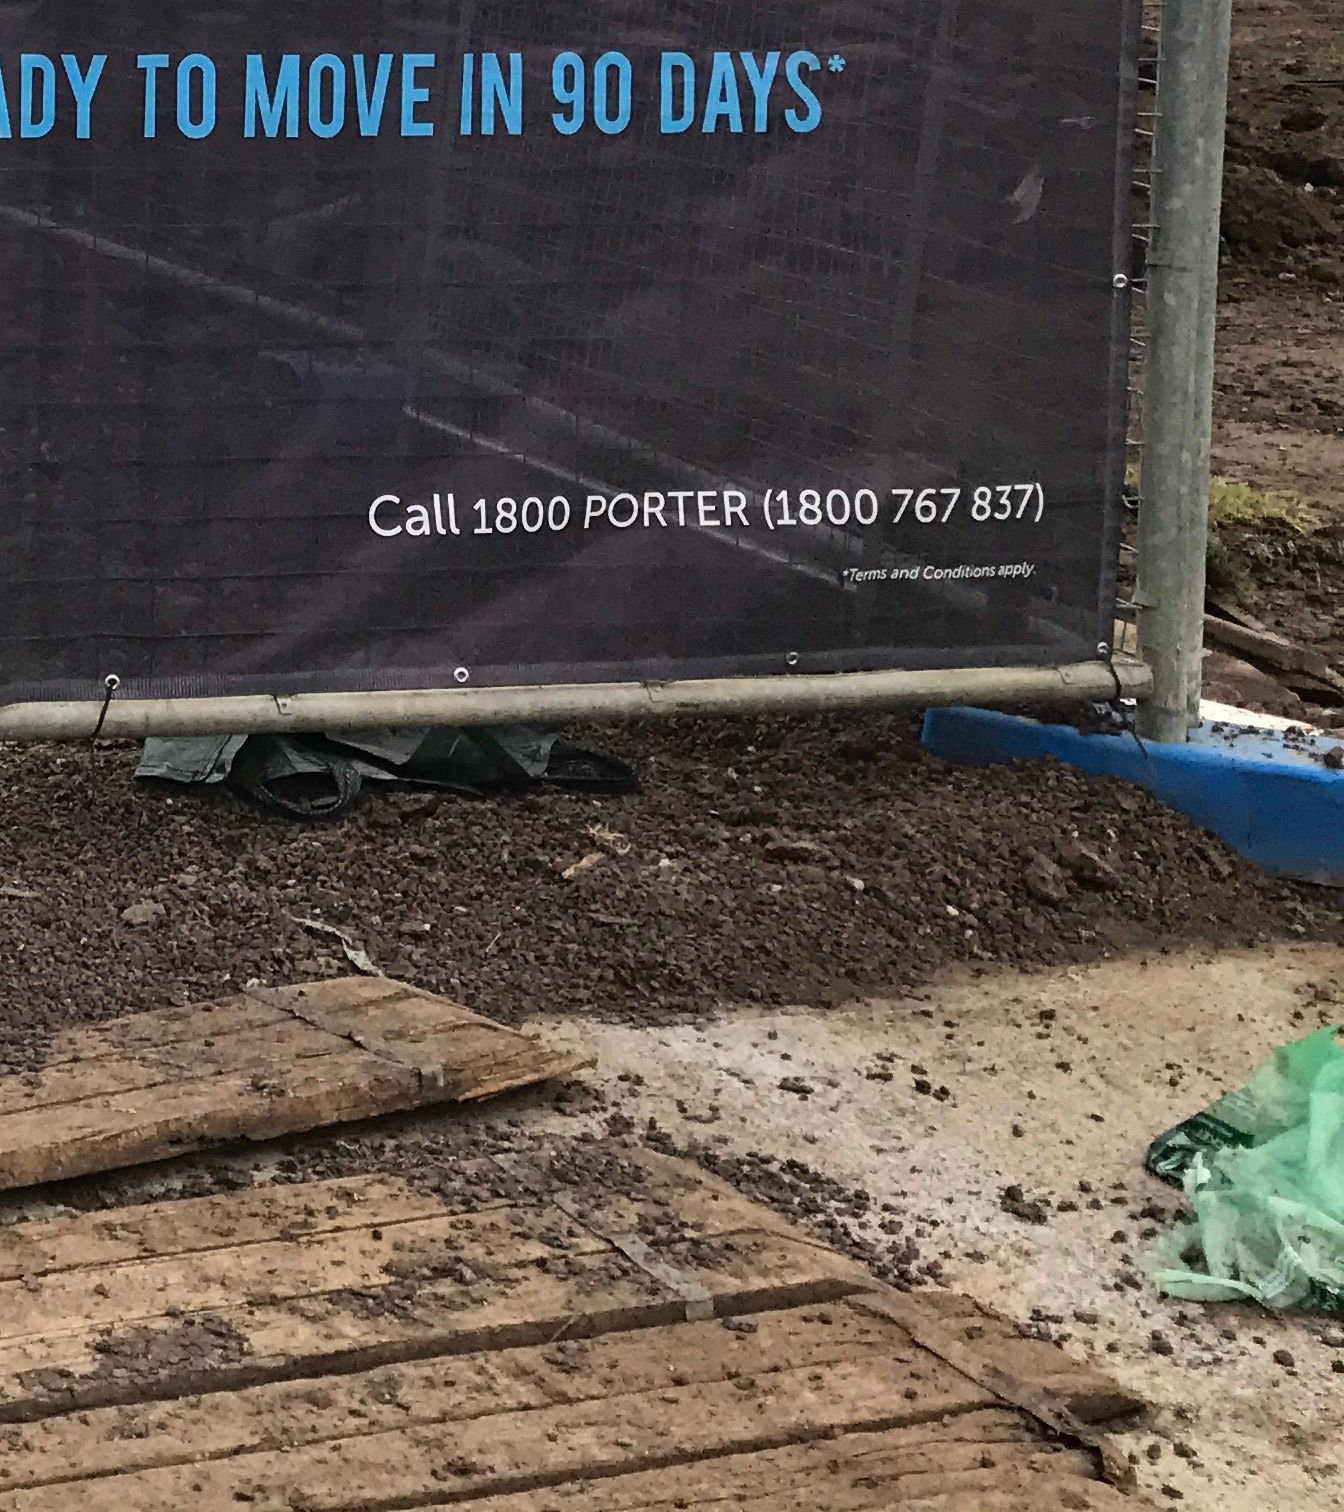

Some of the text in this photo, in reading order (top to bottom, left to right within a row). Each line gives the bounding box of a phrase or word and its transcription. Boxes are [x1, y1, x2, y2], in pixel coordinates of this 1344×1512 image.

[136, 52, 217, 140] TO
[244, 52, 436, 139] MOVE
[460, 52, 523, 136] IN
[551, 50, 633, 135] 90
[368, 483, 1044, 537] Call 1800 PORTER (1800 767 837)
[890, 565, 921, 580] and
[923, 565, 996, 580] Conditions
[997, 561, 1036, 579] apply.
